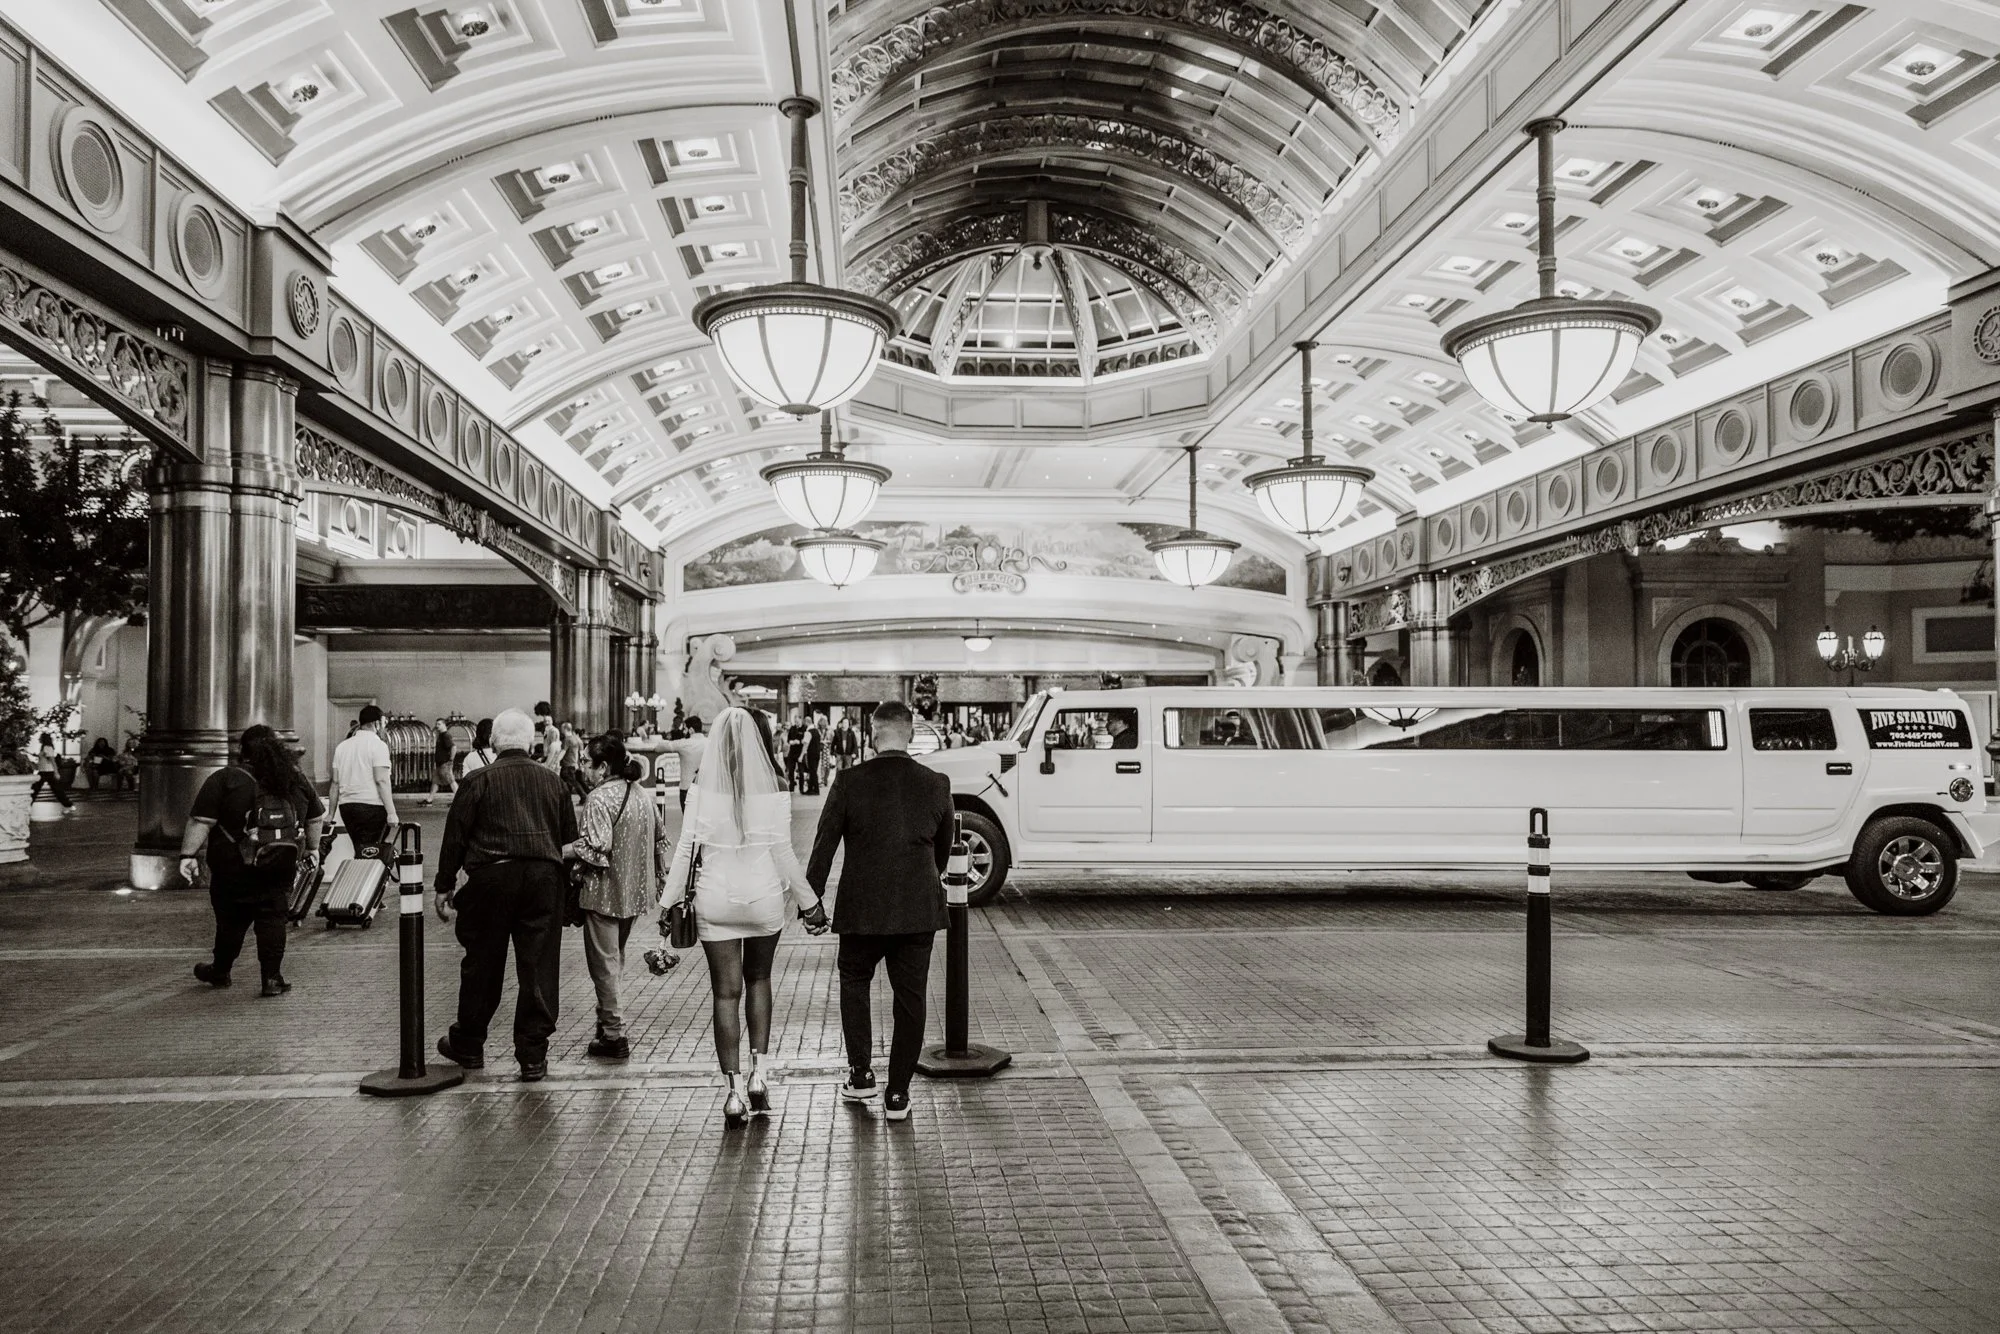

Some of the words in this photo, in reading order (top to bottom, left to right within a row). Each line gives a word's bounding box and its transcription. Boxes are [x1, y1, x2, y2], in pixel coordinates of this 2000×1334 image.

[965, 573, 1016, 585] BELLAGIO
[1870, 711, 1896, 730] FIVE
[1896, 711, 1926, 724] STAR
[1926, 711, 1957, 730] LIMO
